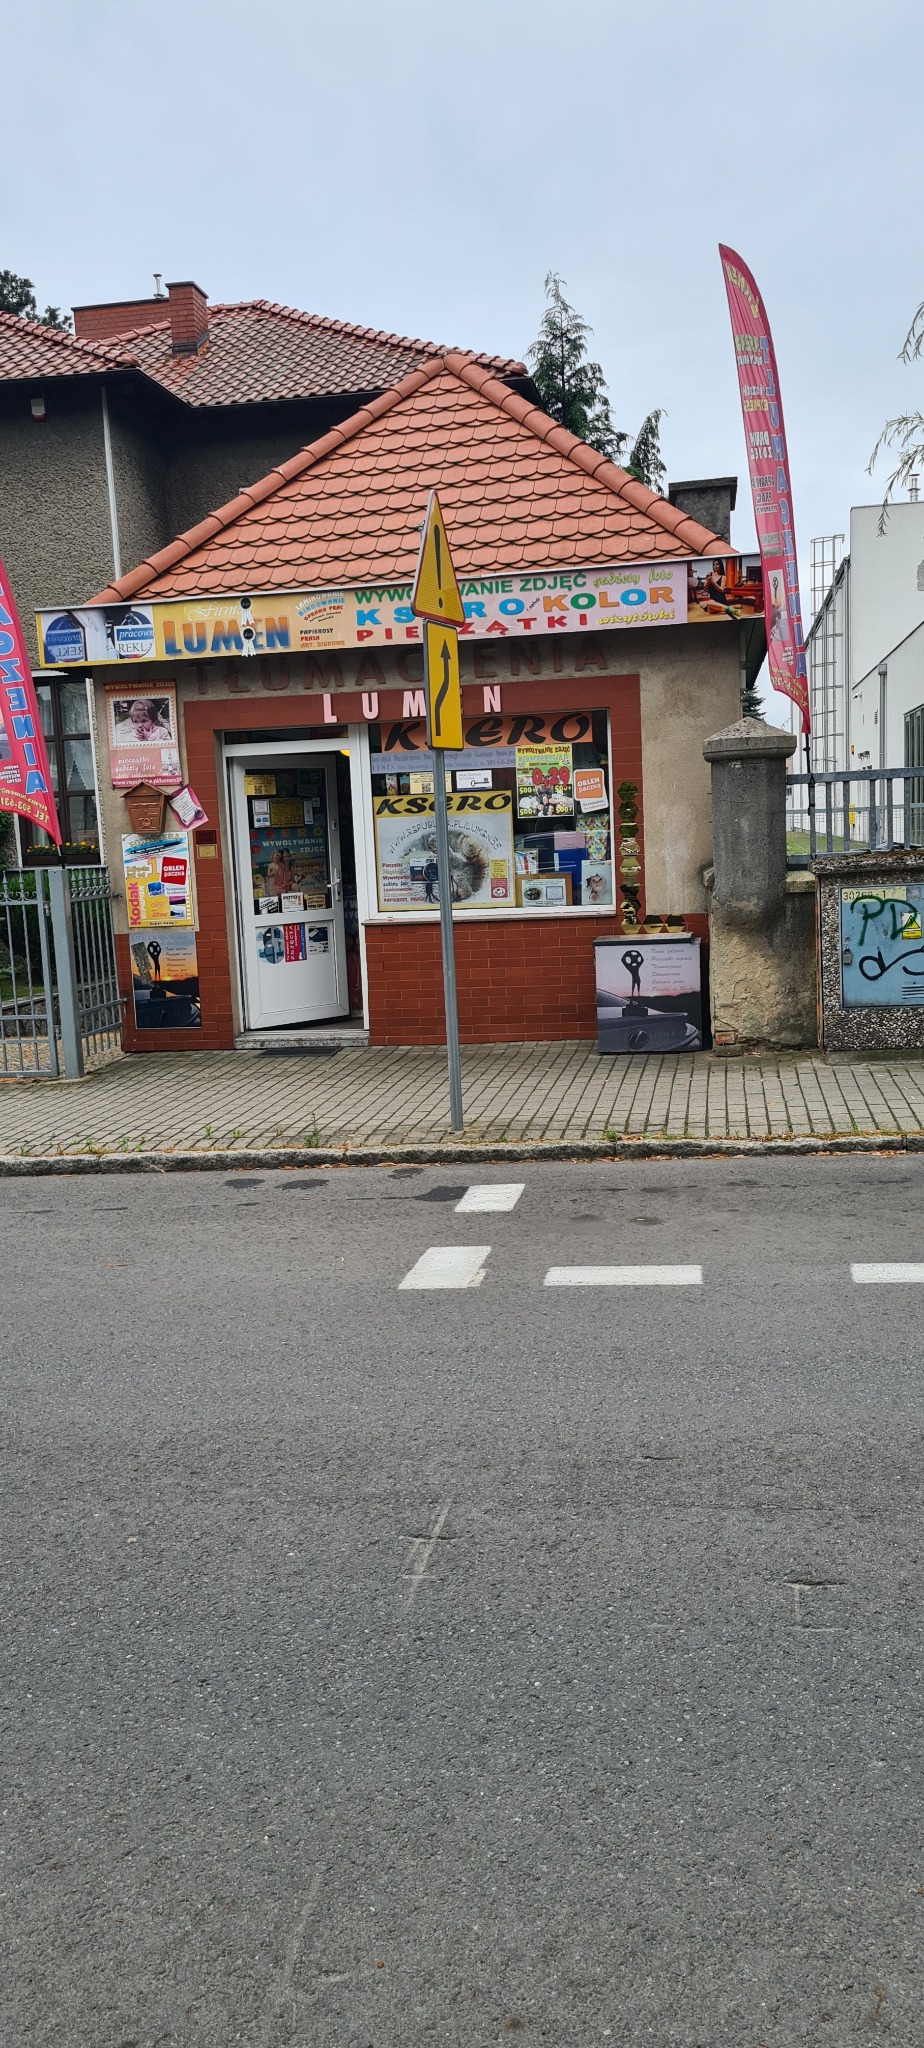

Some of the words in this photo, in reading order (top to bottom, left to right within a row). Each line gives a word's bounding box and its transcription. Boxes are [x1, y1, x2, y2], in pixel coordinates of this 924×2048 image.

[649, 567, 674, 582] foto
[354, 580, 514, 605] WYWWANIE
[519, 572, 587, 592] ZDJĘĆ
[356, 598, 525, 626] KSRO
[542, 586, 675, 613] KOLOR
[598, 608, 676, 626] wizytówki
[163, 616, 290, 655] LUMEN
[356, 613, 588, 642] PIEZĄTKI
[187, 637, 608, 695] TŁUMACENIA
[322, 685, 501, 724] LUMN
[384, 711, 590, 751] KERO
[519, 786, 536, 795] 500+
[532, 766, 571, 791] 0,29
[577, 777, 600, 787] ORLEN
[578, 783, 601, 793] paczka
[376, 793, 511, 815] KSERO
[519, 808, 536, 816] 500+
[555, 806, 573, 814] 500+
[163, 870, 185, 878] paczka
[128, 881, 141, 926] Kodak
